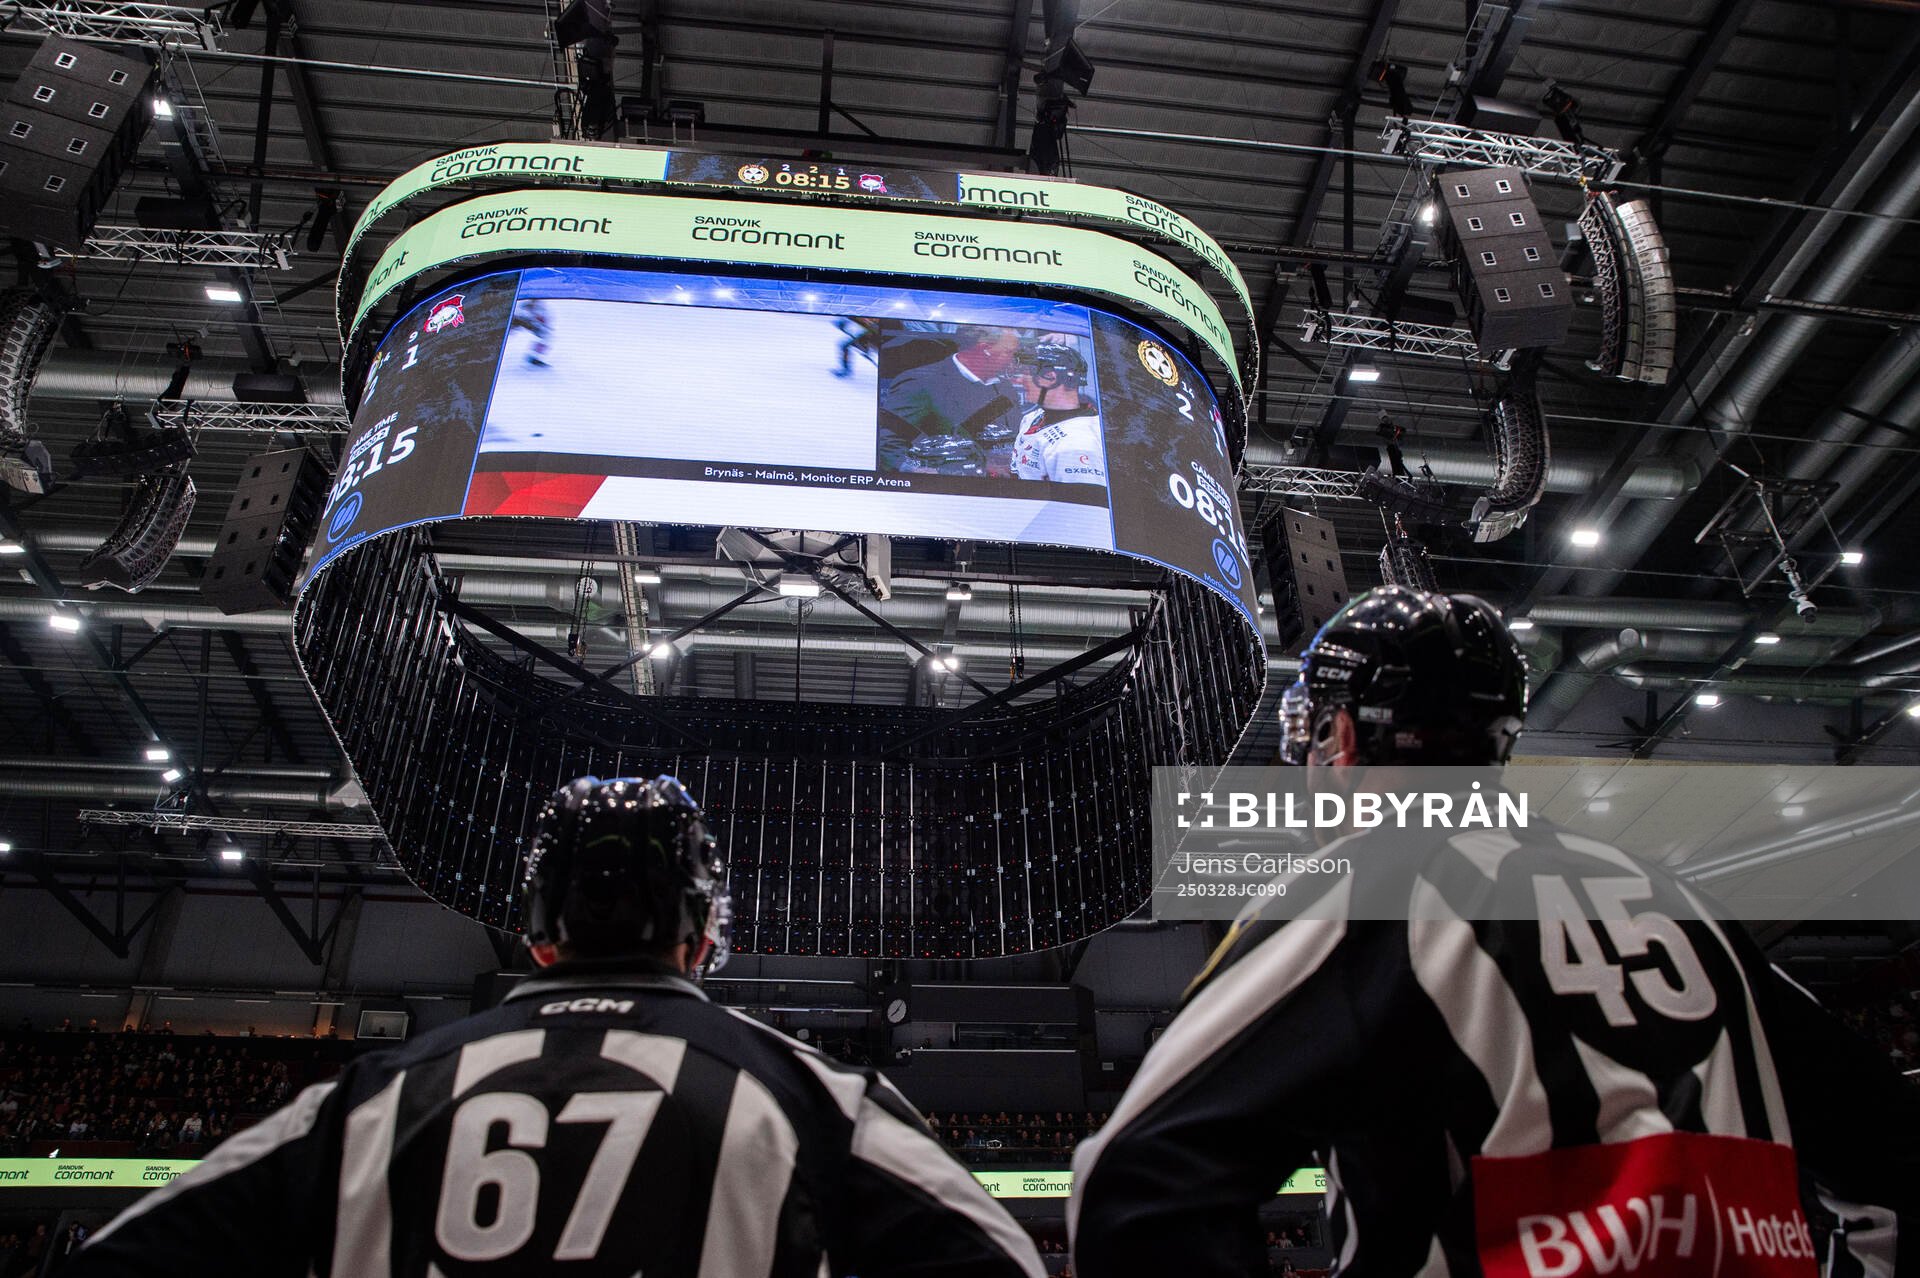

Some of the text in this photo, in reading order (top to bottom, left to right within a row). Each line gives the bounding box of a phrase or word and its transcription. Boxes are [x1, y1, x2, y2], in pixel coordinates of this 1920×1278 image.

[436, 146, 498, 167] SANDVIK
[430, 155, 584, 183] coromant
[775, 171, 851, 190] 08:15
[781, 163, 846, 176] 2 2 1
[960, 187, 1050, 207] mant
[465, 207, 529, 224] SANDVIK
[1125, 195, 1181, 224] SANDVIK
[460, 216, 612, 240] coromant
[694, 216, 761, 229] SANDVIK
[692, 227, 845, 251] coromant
[914, 231, 979, 244] SANDVIK
[1127, 206, 1234, 278] coromant
[913, 241, 1063, 267] coromant
[1132, 259, 1182, 291] SANDVIK
[1134, 270, 1228, 347] coromant
[408, 331, 419, 343] 9
[402, 344, 419, 371] 1
[364, 376, 379, 405] 2
[1181, 380, 1195, 399] 14
[1175, 392, 1195, 422] 2
[374, 411, 399, 433] TIME
[322, 426, 419, 520] 08:15
[704, 467, 744, 479] Brynäs
[755, 469, 798, 482] Malmö,
[801, 472, 847, 484] Monitor
[850, 475, 873, 485] ERP
[876, 476, 911, 488] Arena
[1191, 461, 1216, 486] GAME
[1316, 665, 1352, 681] CCM
[1532, 873, 1718, 1028] 45
[540, 998, 635, 1016] CCM
[54, 1170, 114, 1180] coromant
[435, 1090, 665, 1262] 67
[1516, 1193, 1815, 1278] BWH Hotels
